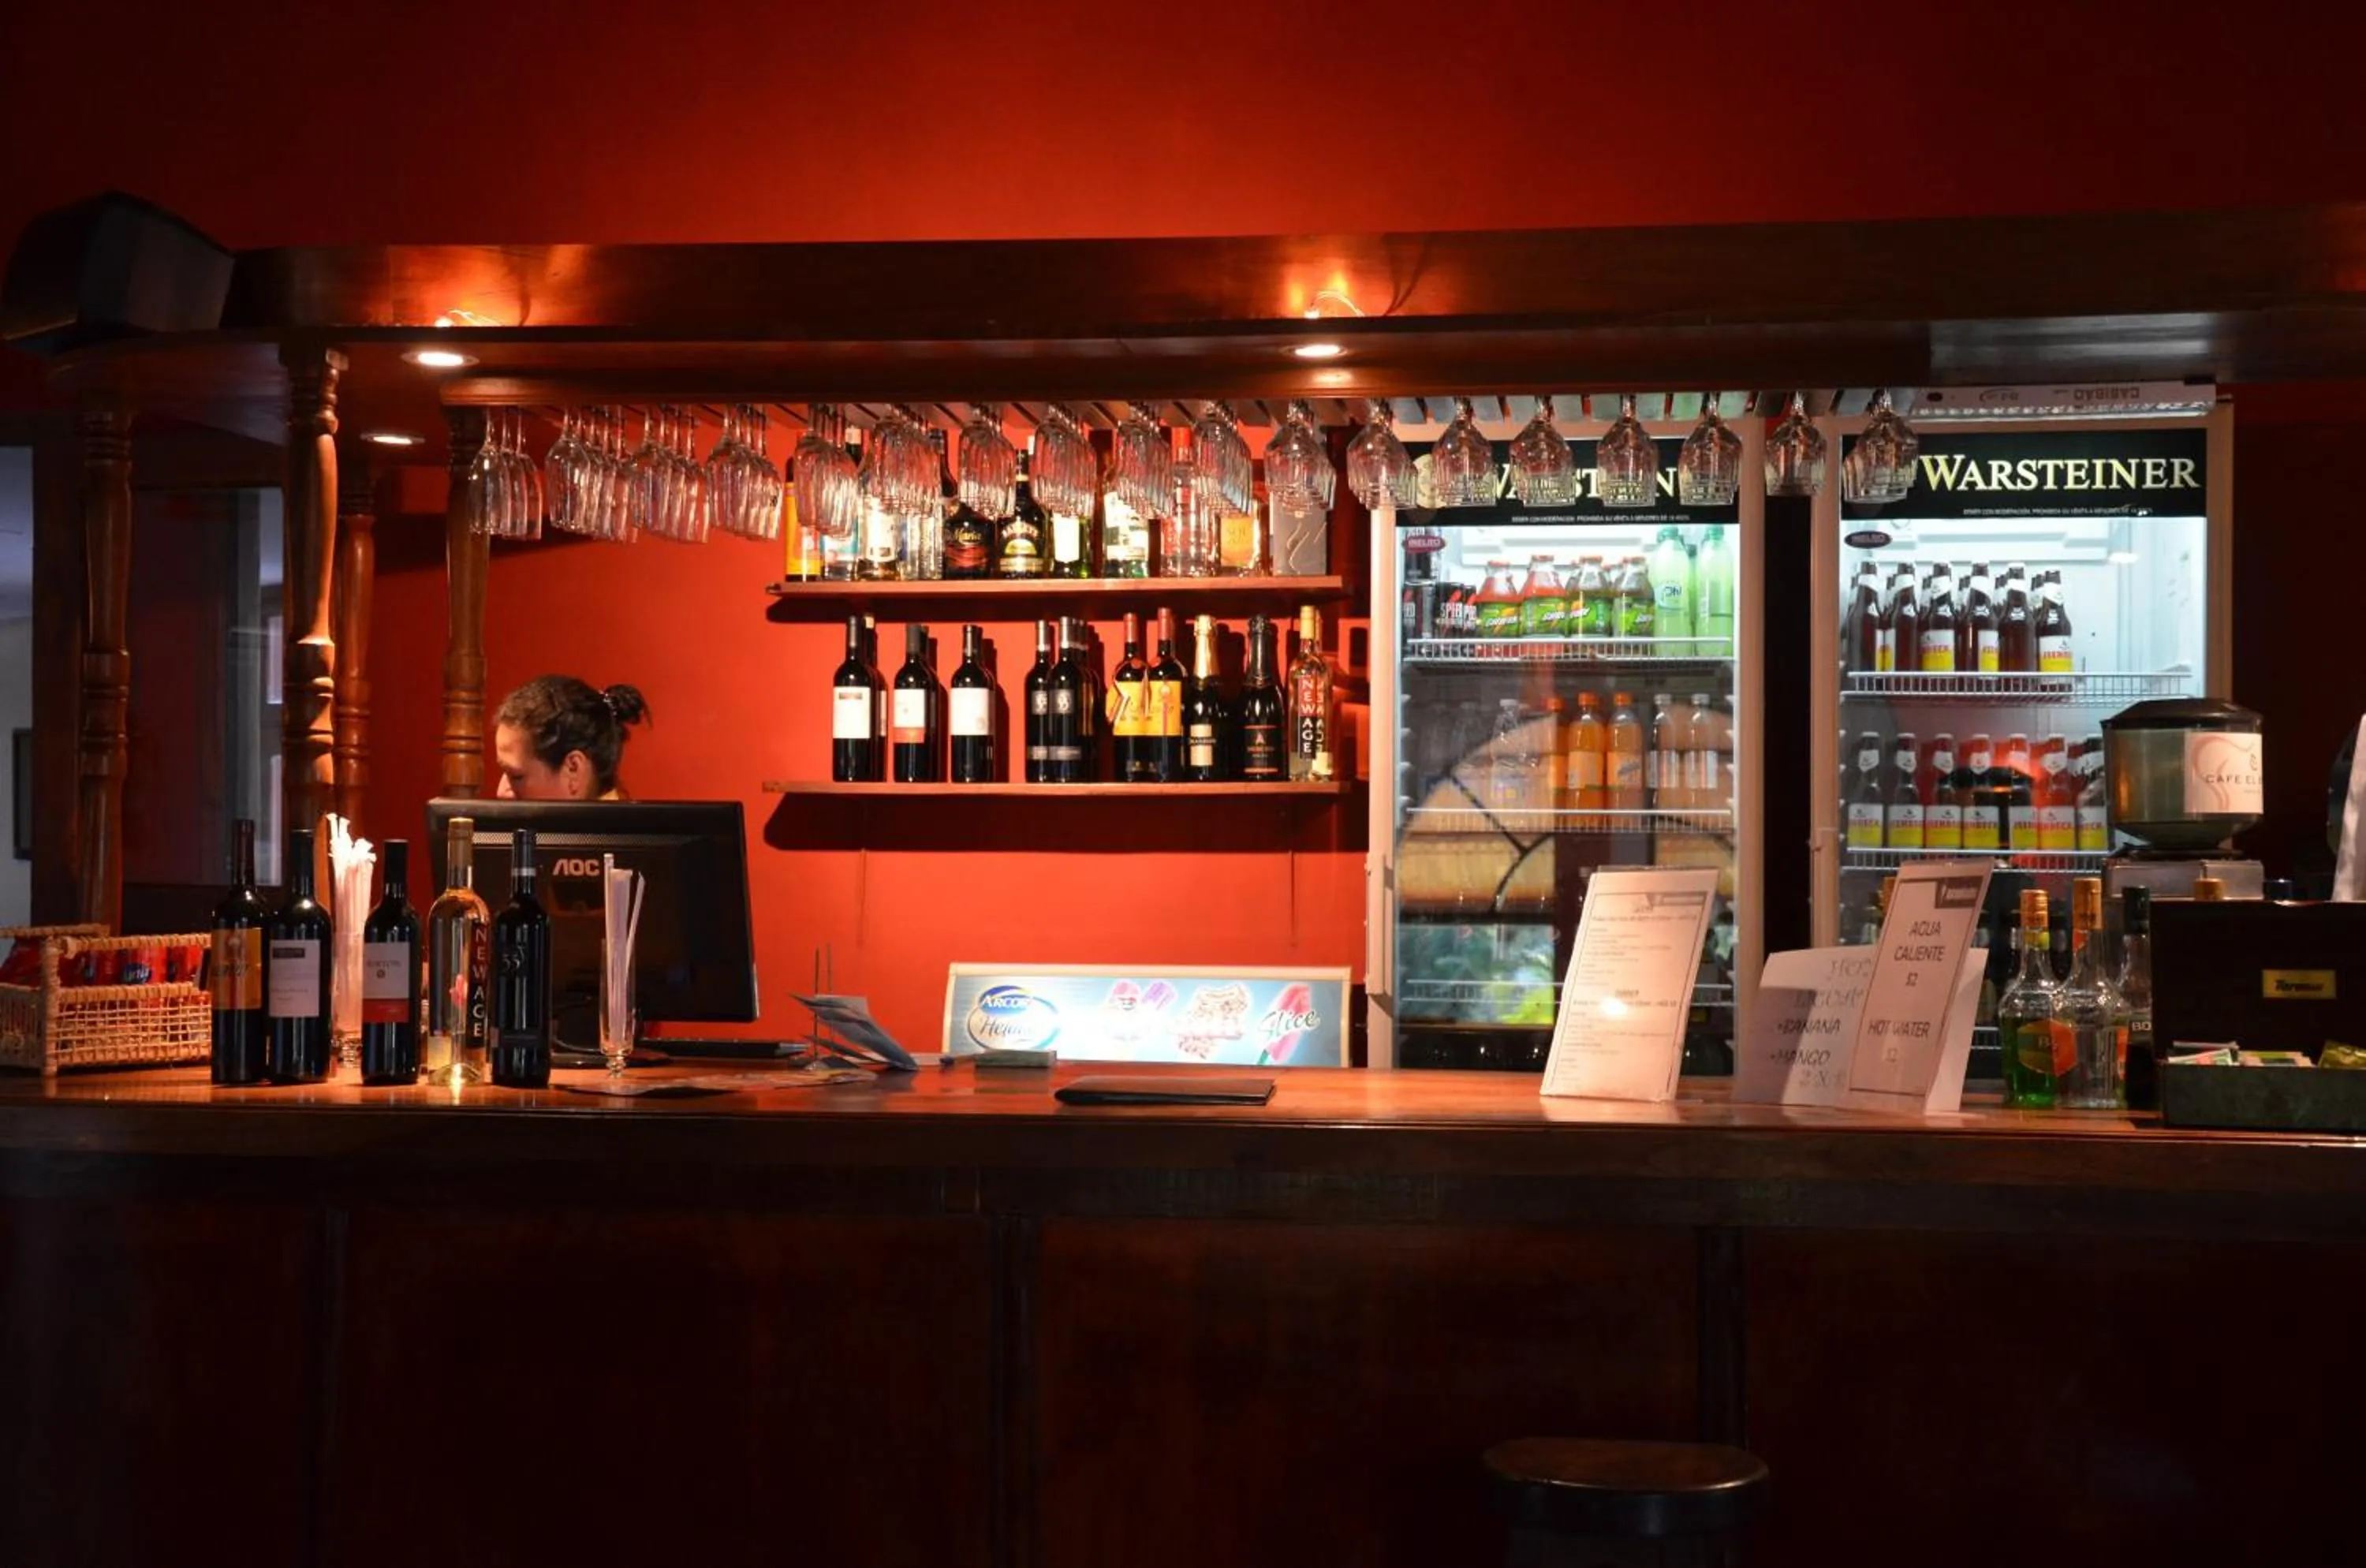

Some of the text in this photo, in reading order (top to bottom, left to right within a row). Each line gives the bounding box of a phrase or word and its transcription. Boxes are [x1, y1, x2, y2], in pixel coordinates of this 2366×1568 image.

[1920, 454, 2201, 492] WARSTEINER
[552, 858, 600, 876] AOC
[1894, 946, 1946, 961] CALIENTE
[472, 928, 488, 1036] NEW AGE
[1868, 1020, 1931, 1039] HOT WATER
